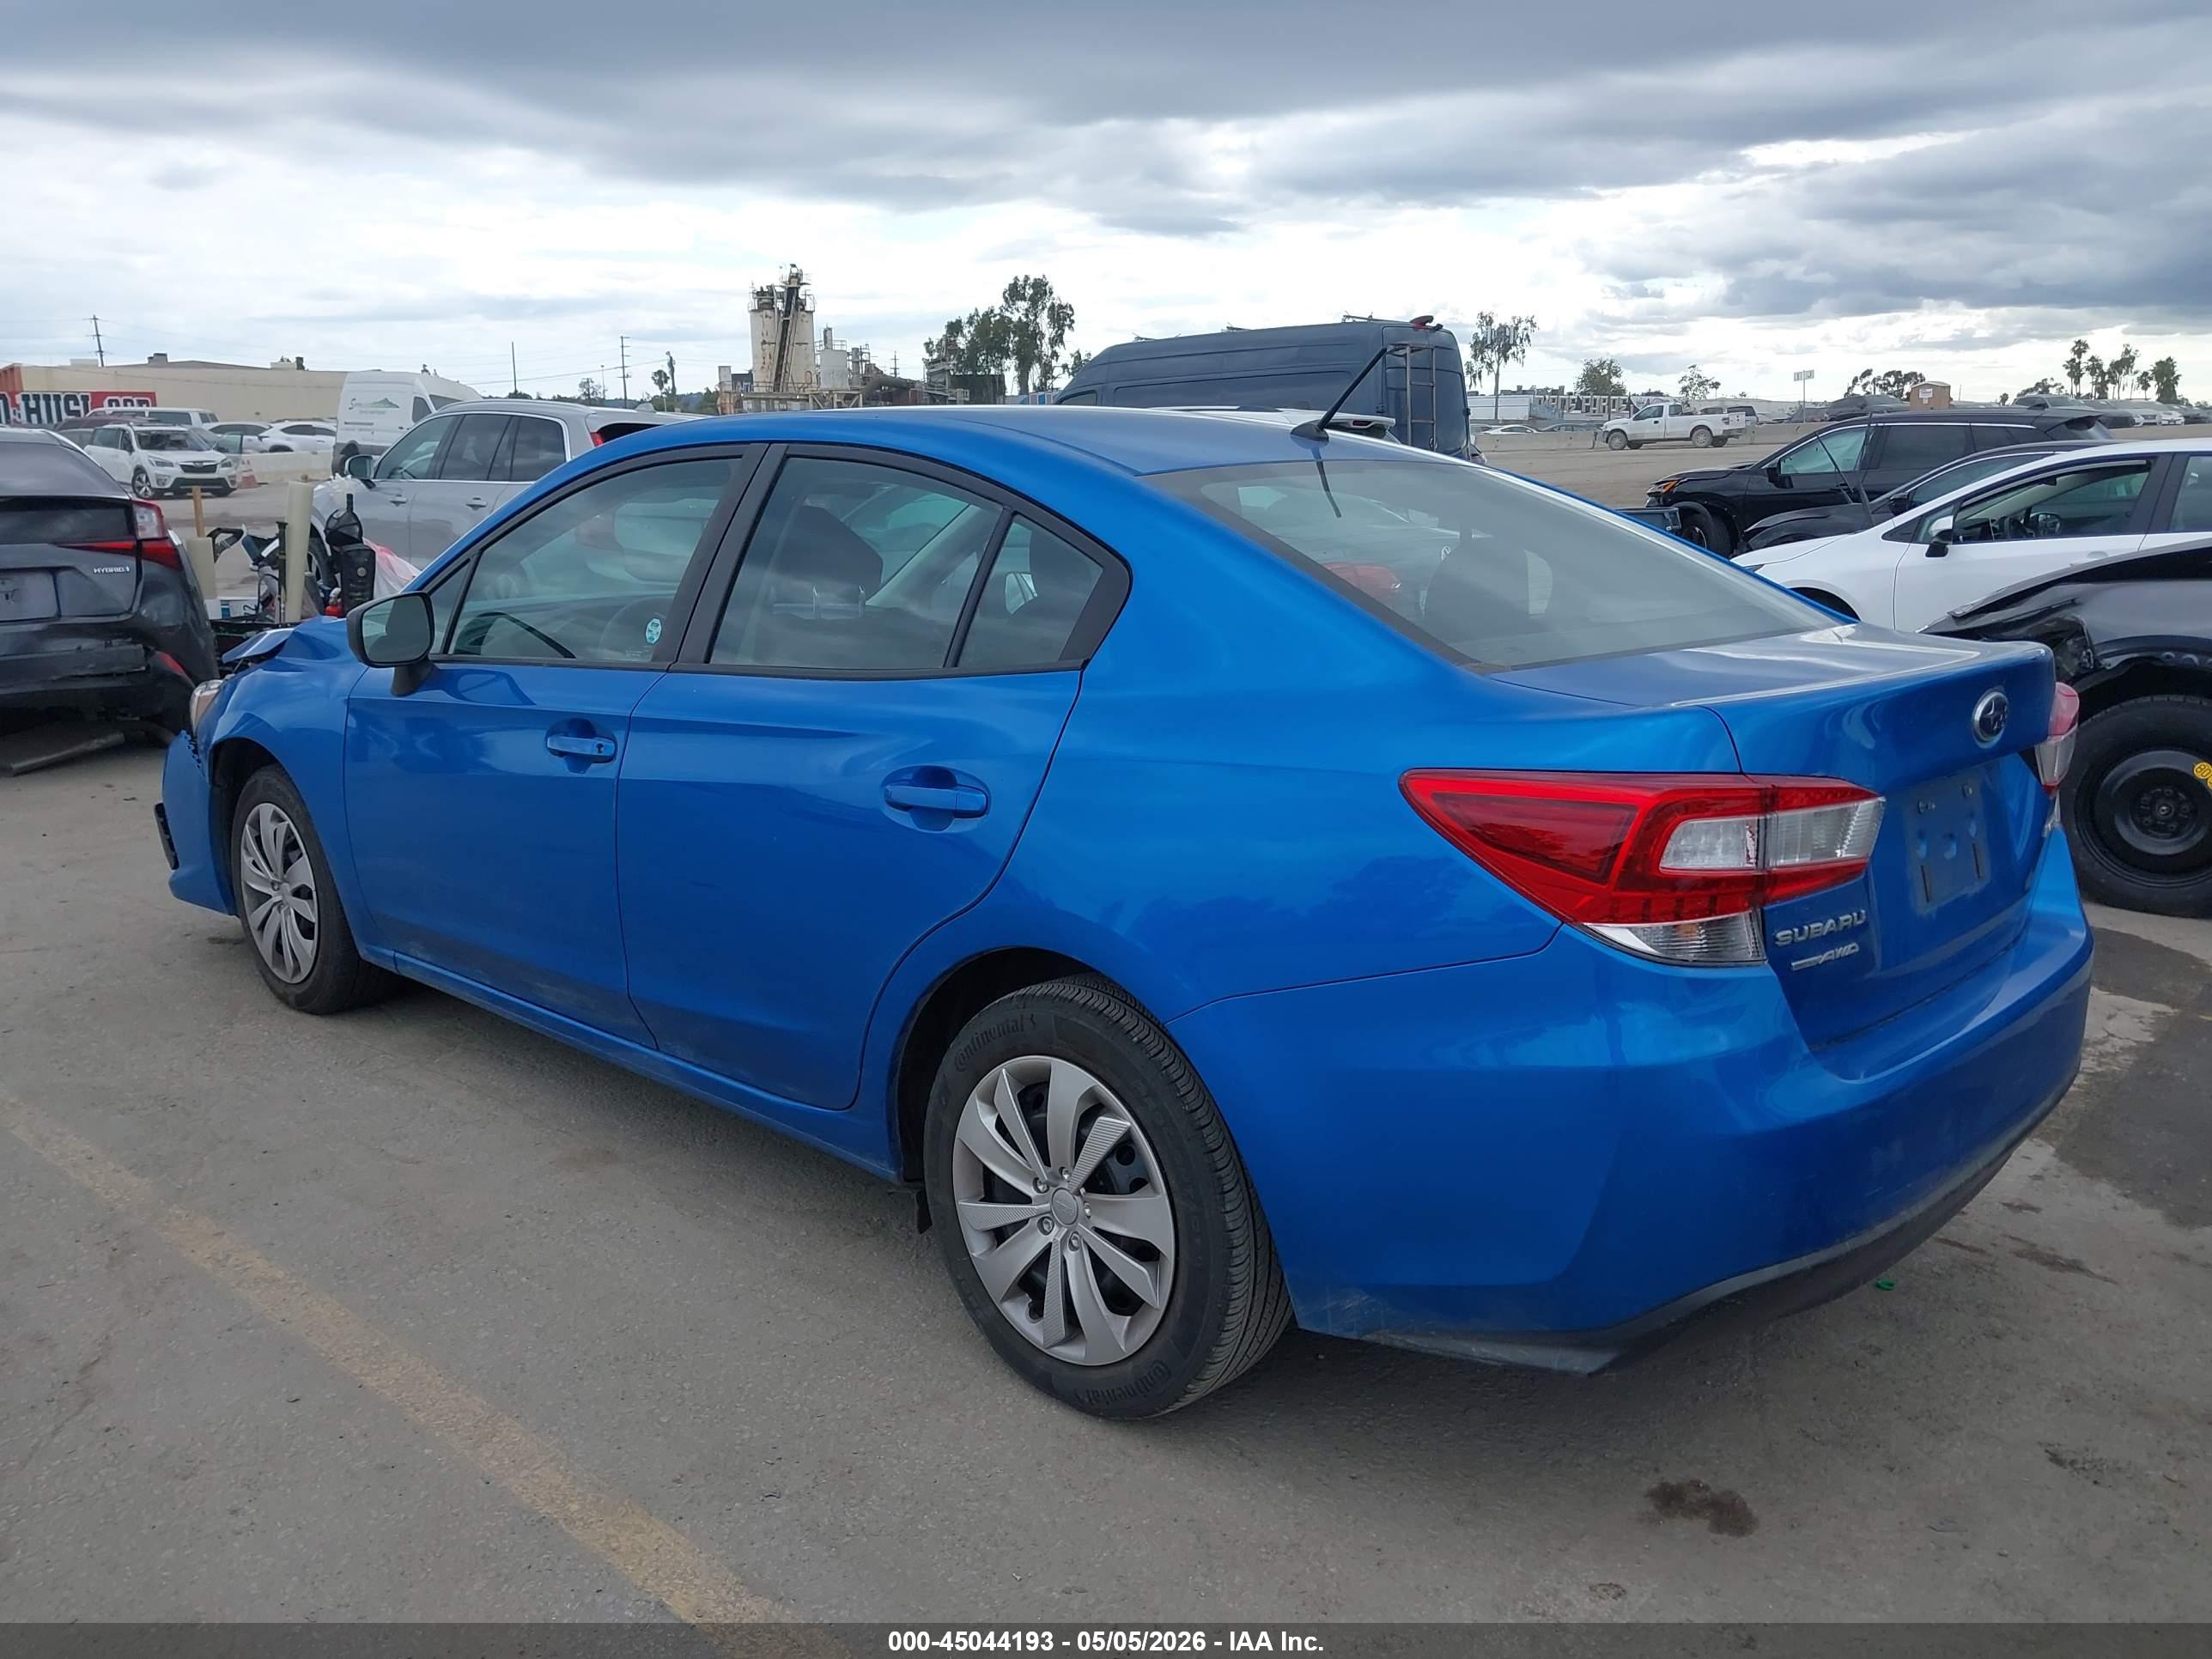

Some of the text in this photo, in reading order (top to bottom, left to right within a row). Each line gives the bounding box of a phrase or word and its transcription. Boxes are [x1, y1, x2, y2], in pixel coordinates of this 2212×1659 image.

[1774, 909, 1866, 946] SUBARU
[1819, 942, 1859, 964] AWD
[954, 1014, 1024, 1073] Continental
